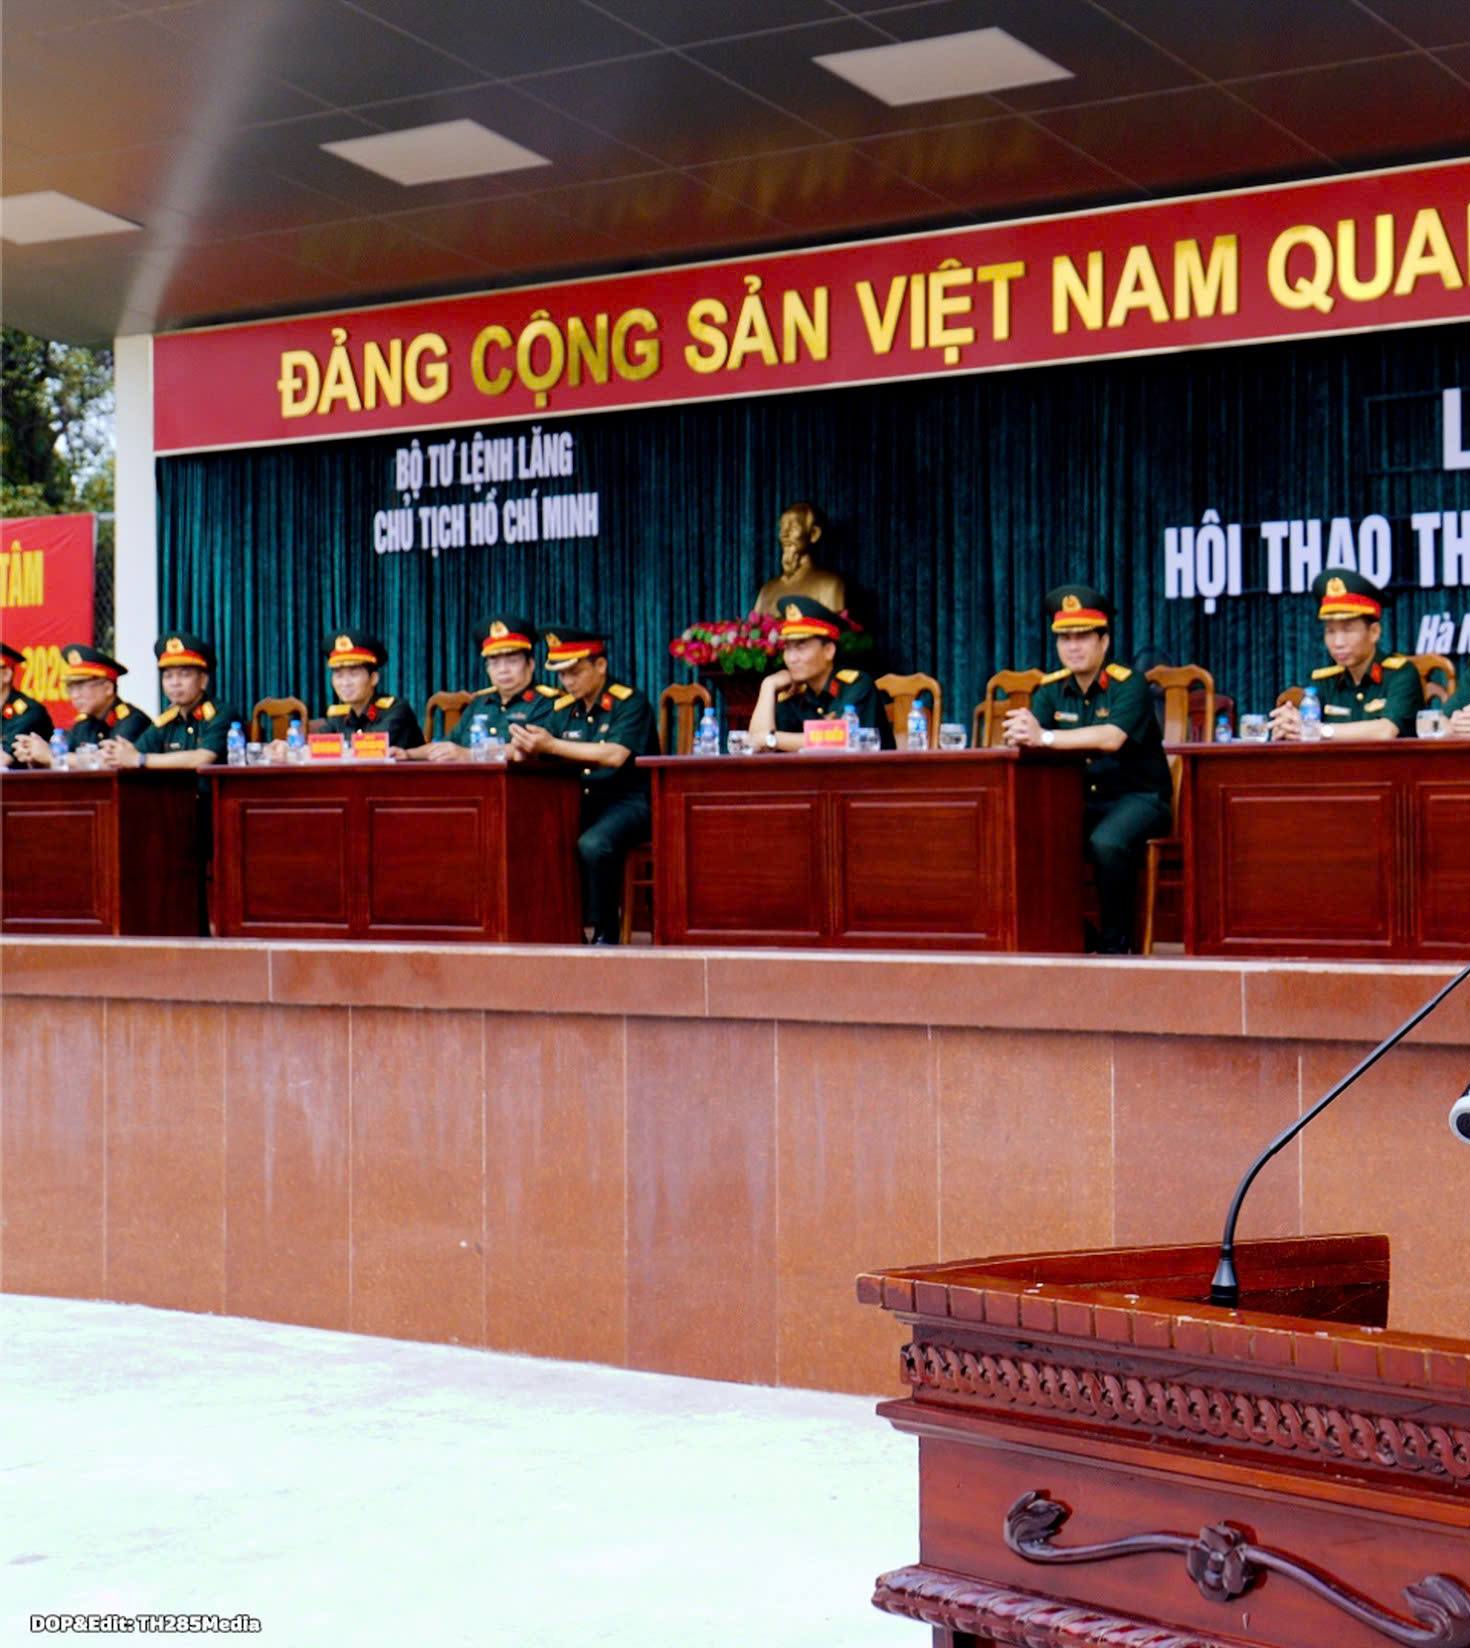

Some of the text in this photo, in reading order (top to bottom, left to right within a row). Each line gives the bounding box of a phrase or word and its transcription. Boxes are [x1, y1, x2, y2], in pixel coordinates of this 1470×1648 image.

[277, 328, 449, 418] ĐẢNG
[471, 310, 660, 408] CỘNG
[684, 276, 828, 374] SẢN
[856, 259, 1025, 365] VIỆT
[1052, 235, 1238, 334] NAM
[396, 426, 573, 500] BỘ TƯ LỆNH LĂNG
[373, 488, 599, 558] CHỦ TỊCH HỒ CHÍ MINH
[1164, 509, 1242, 614] HỘI
[1261, 514, 1392, 594] THAO
[1416, 612, 1455, 656] Hà
